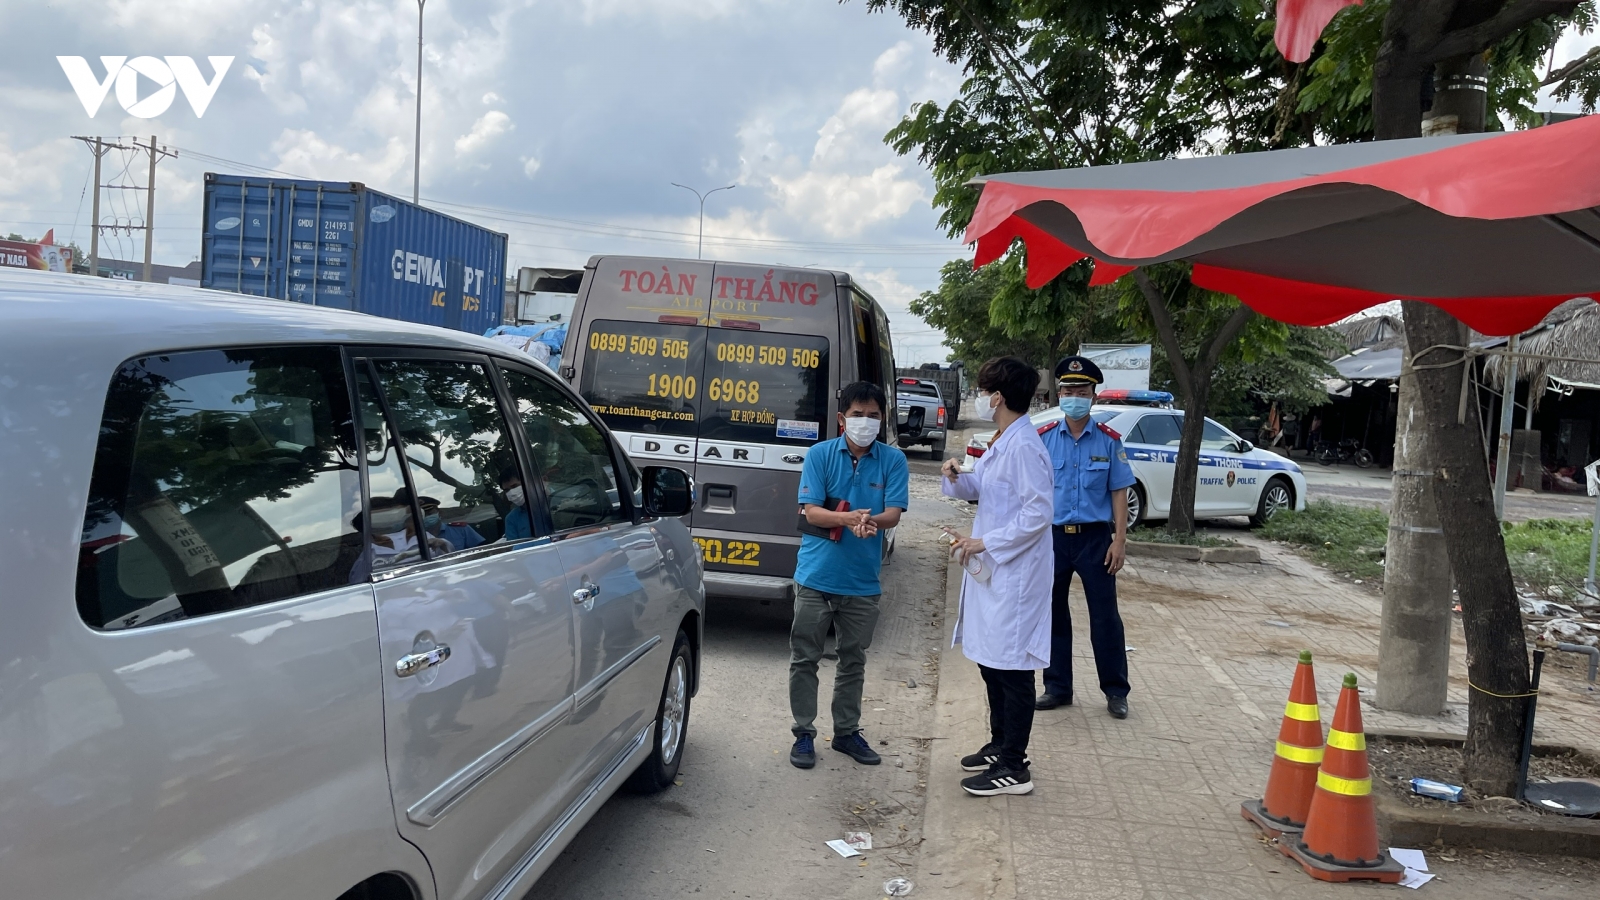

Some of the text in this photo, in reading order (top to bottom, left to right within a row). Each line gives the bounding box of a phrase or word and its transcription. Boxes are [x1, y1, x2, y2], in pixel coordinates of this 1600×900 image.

[297, 218, 314, 228] GMDU
[324, 221, 347, 230] 214193
[7, 253, 28, 267] NASA
[391, 249, 485, 296] GEMAPT
[619, 265, 819, 306] TOÀN THẮNG
[590, 332, 689, 360] 0899 509 505
[717, 343, 819, 368] 0899 509 506
[647, 373, 760, 404] 1900 6968
[589, 400, 694, 421] ww.toanthangcar.com
[731, 409, 740, 422] XE
[741, 410, 756, 424] HỢP
[756, 407, 775, 425] ĐỒNG
[1150, 451, 1168, 463] SÁT
[1213, 456, 1244, 469] THÔNG
[1200, 477, 1257, 486] TRAFFIC POLICE
